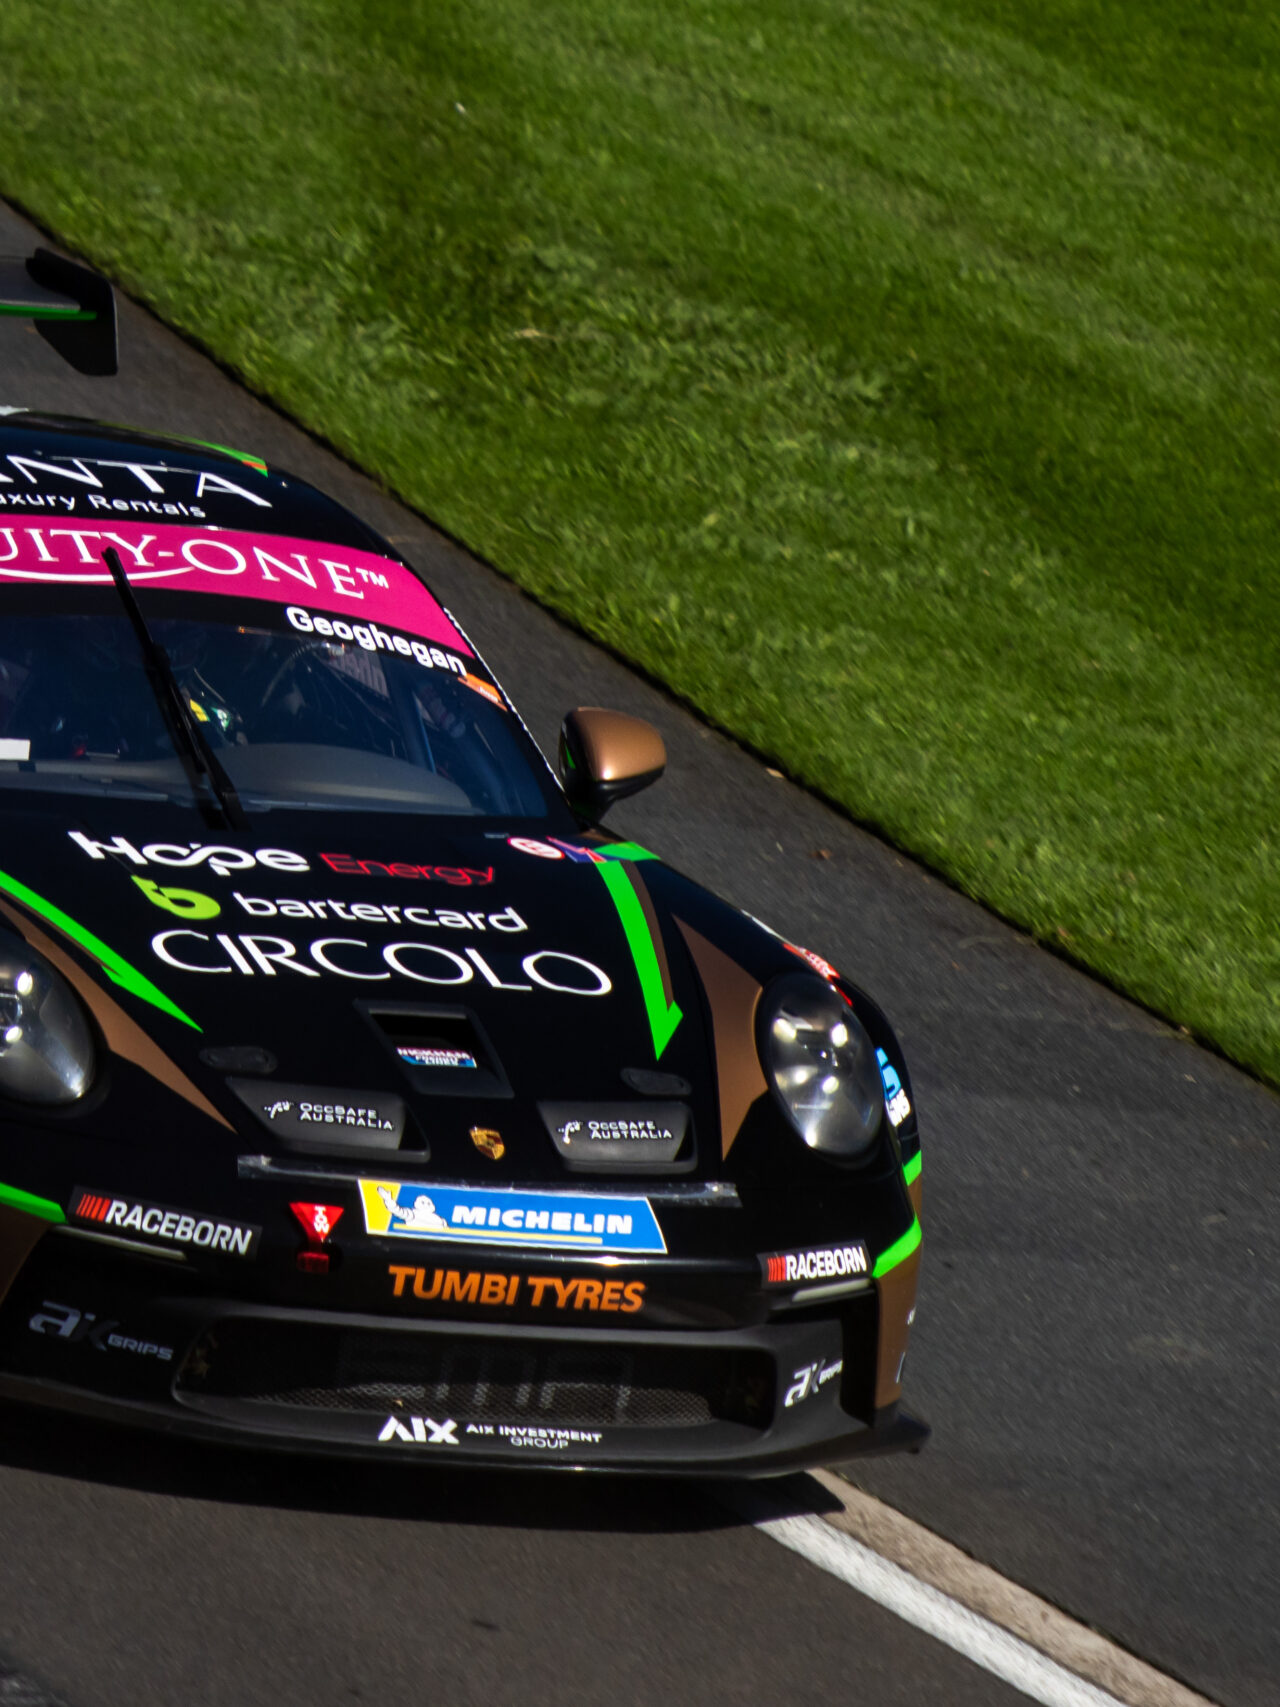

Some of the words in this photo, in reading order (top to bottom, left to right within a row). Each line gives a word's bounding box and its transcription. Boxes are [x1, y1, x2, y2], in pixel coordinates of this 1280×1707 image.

[87, 493, 207, 518] Rentals
[286, 606, 468, 677] Geoghegan
[67, 831, 312, 876] Hope
[319, 852, 496, 886] Energy
[232, 891, 529, 934] bartercard
[150, 929, 613, 996] CIRCOLO
[300, 1110, 394, 1131] AUSTRALIA
[104, 1199, 254, 1257] RACEBORN
[313, 1204, 330, 1234] TOW
[450, 1204, 633, 1235] MICHELIN
[786, 1246, 868, 1282] RACEBORN
[388, 1264, 520, 1306] TUMBI
[526, 1276, 648, 1314] TYRES
[106, 1333, 175, 1362] GRIPS
[377, 1414, 460, 1446] AIX
[465, 1423, 495, 1435] AIX
[498, 1425, 603, 1444] INVESTMENT
[510, 1437, 570, 1449] GROUP
